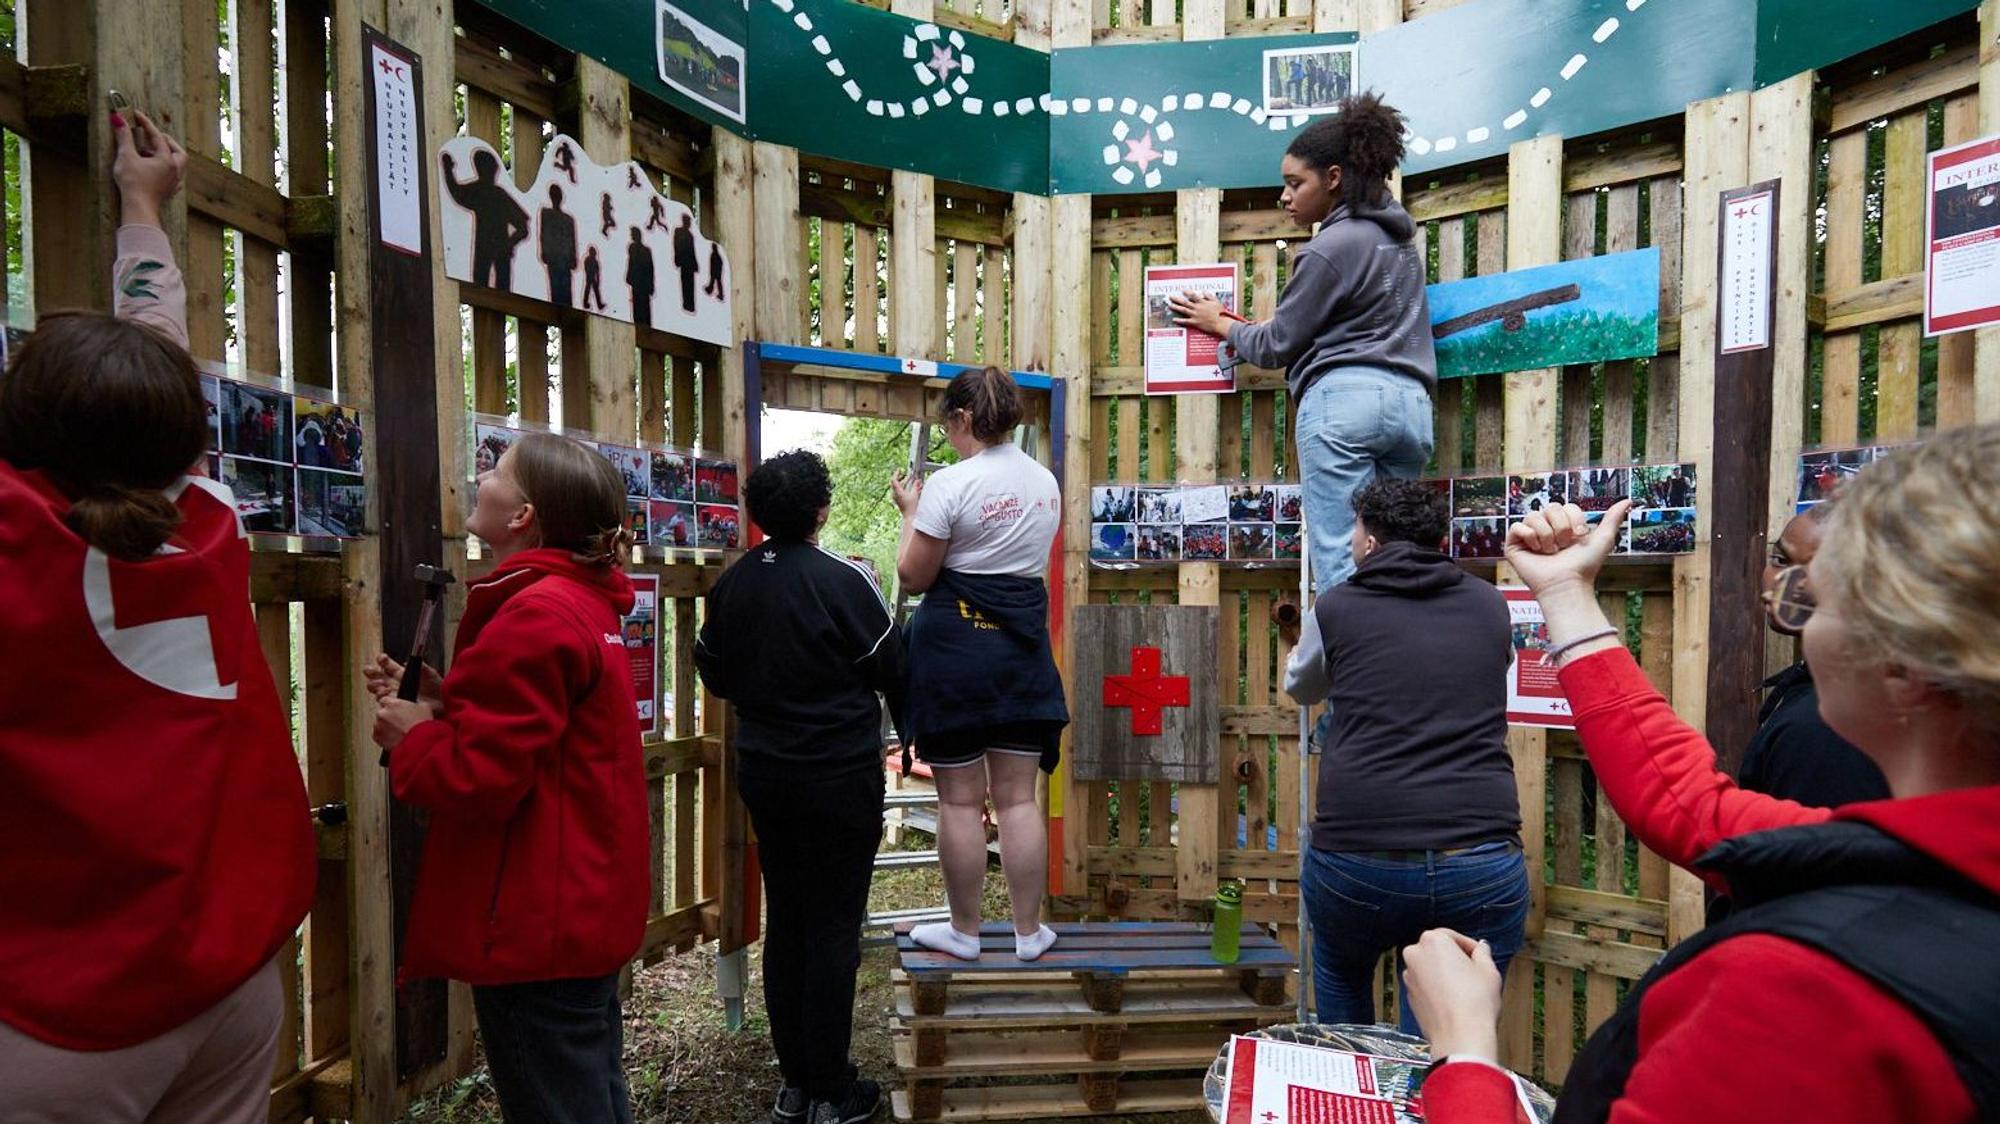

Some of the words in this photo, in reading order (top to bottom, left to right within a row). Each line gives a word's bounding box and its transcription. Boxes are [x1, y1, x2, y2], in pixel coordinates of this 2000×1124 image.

[398, 88, 409, 196] NEUTRALITY
[1734, 270, 1742, 344] PRINCIPLES
[994, 508, 1023, 522] GUSTO
